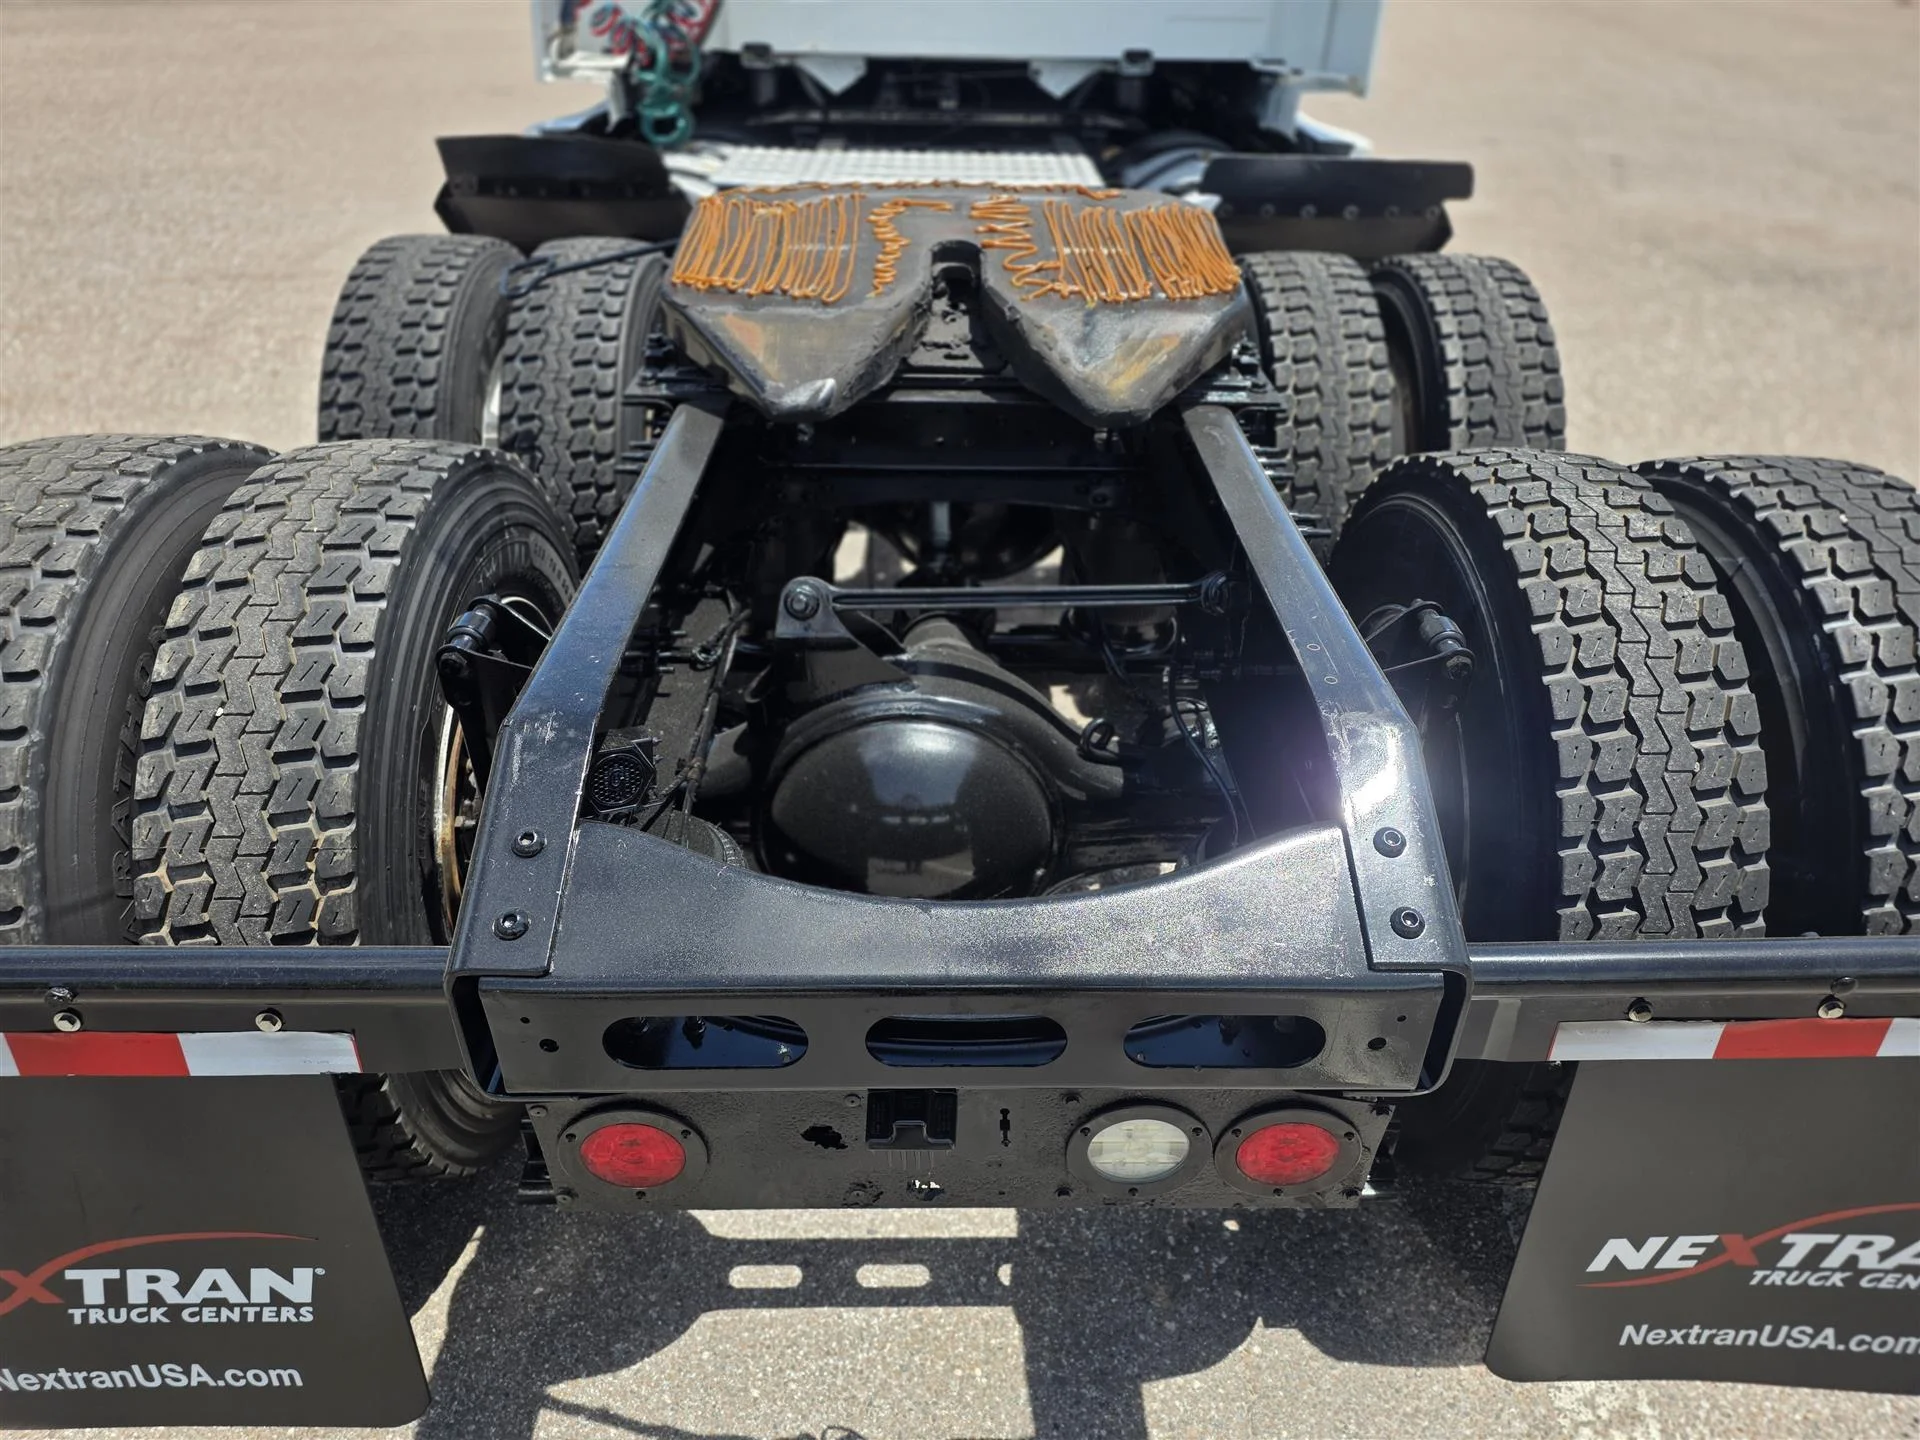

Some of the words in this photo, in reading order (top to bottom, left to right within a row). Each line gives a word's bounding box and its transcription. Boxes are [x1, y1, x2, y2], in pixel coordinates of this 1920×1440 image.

[1749, 1270, 1852, 1287] TRUCK
[68, 1307, 170, 1325] TRUCK
[181, 1306, 314, 1324] CENTERS
